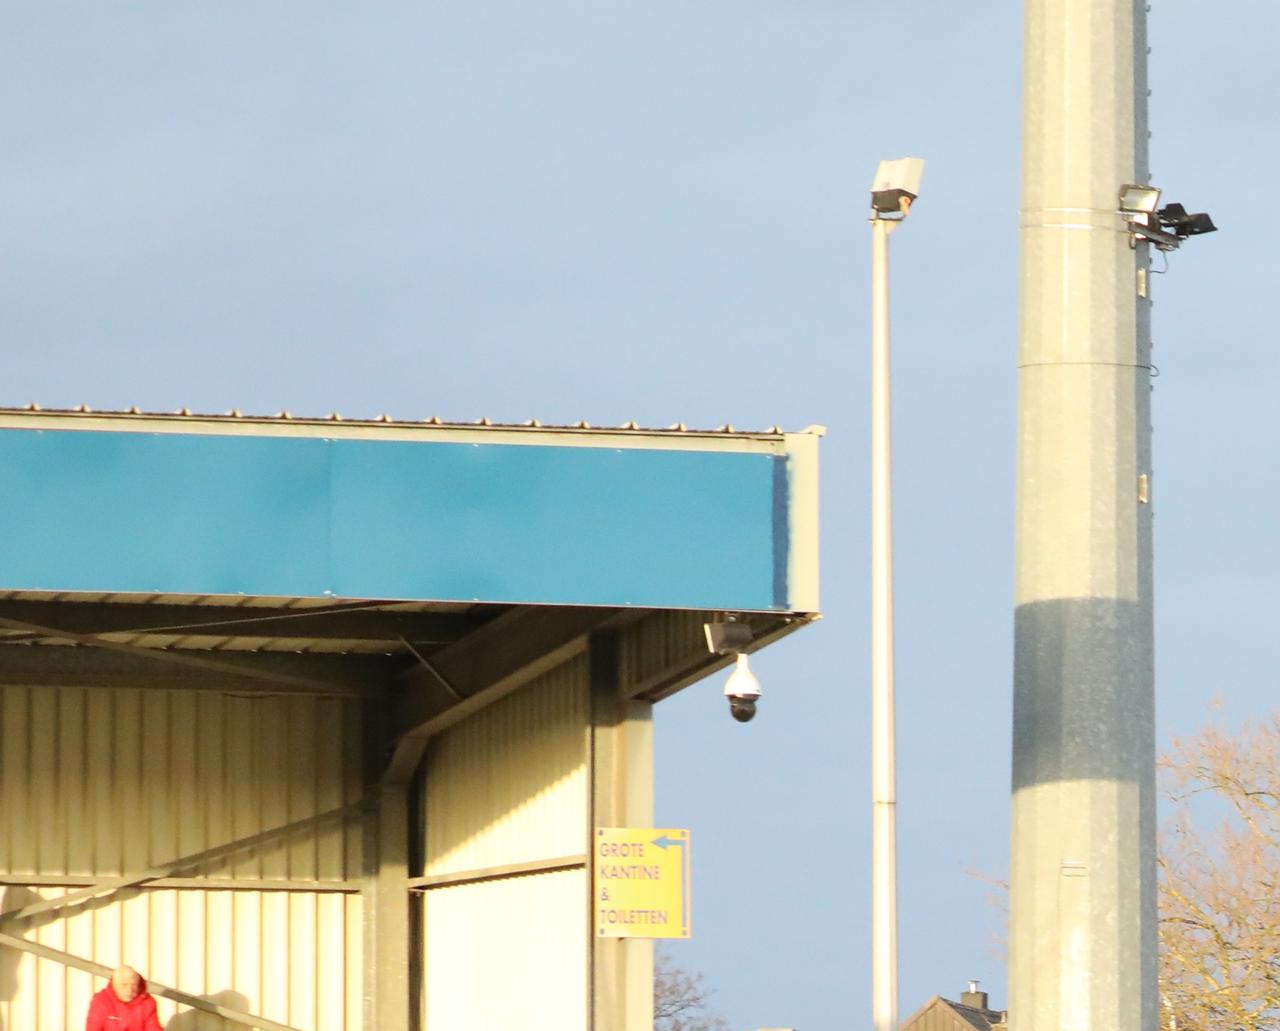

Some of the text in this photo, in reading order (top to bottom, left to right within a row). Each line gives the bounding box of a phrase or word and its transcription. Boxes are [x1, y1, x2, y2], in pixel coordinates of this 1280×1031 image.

[599, 842, 645, 858] GROTE
[599, 865, 661, 880] KANTINE
[600, 887, 609, 901] &
[600, 909, 669, 924] TOILETTEN
